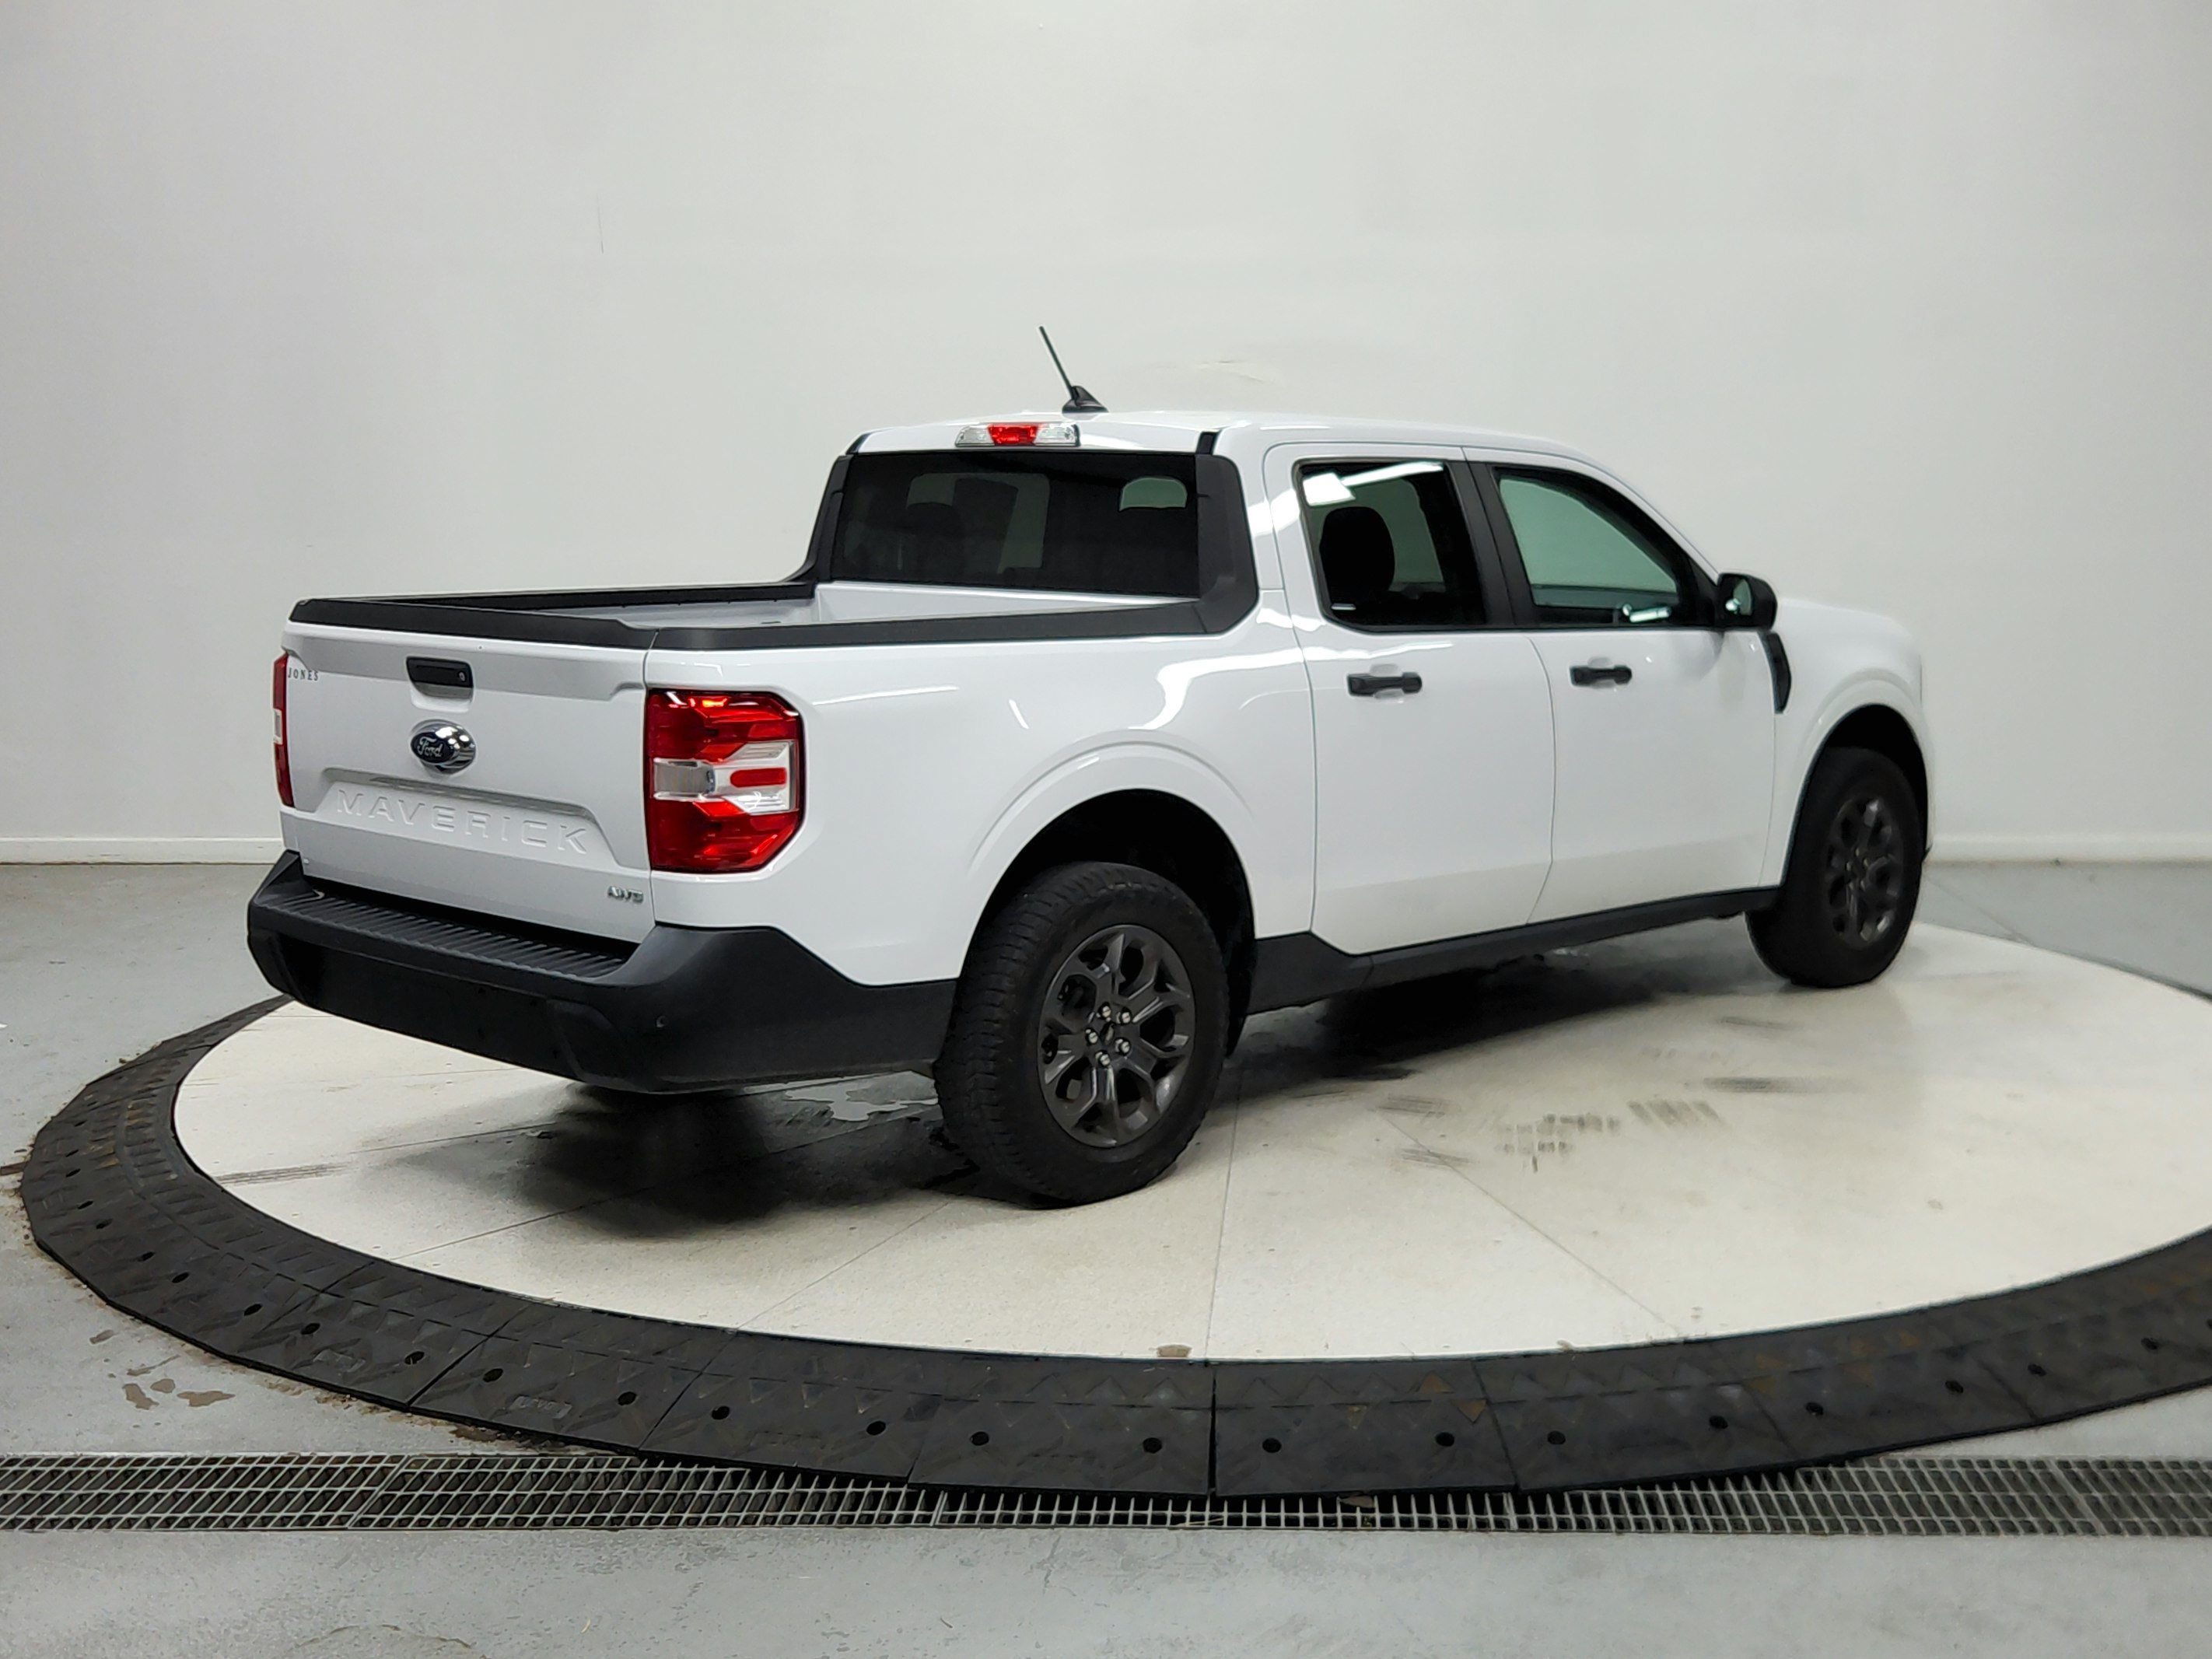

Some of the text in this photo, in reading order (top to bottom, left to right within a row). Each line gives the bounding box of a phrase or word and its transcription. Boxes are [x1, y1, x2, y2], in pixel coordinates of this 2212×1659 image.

[288, 667, 319, 681] JONES
[417, 736, 443, 758] Ford
[337, 789, 587, 854] MAVERICK
